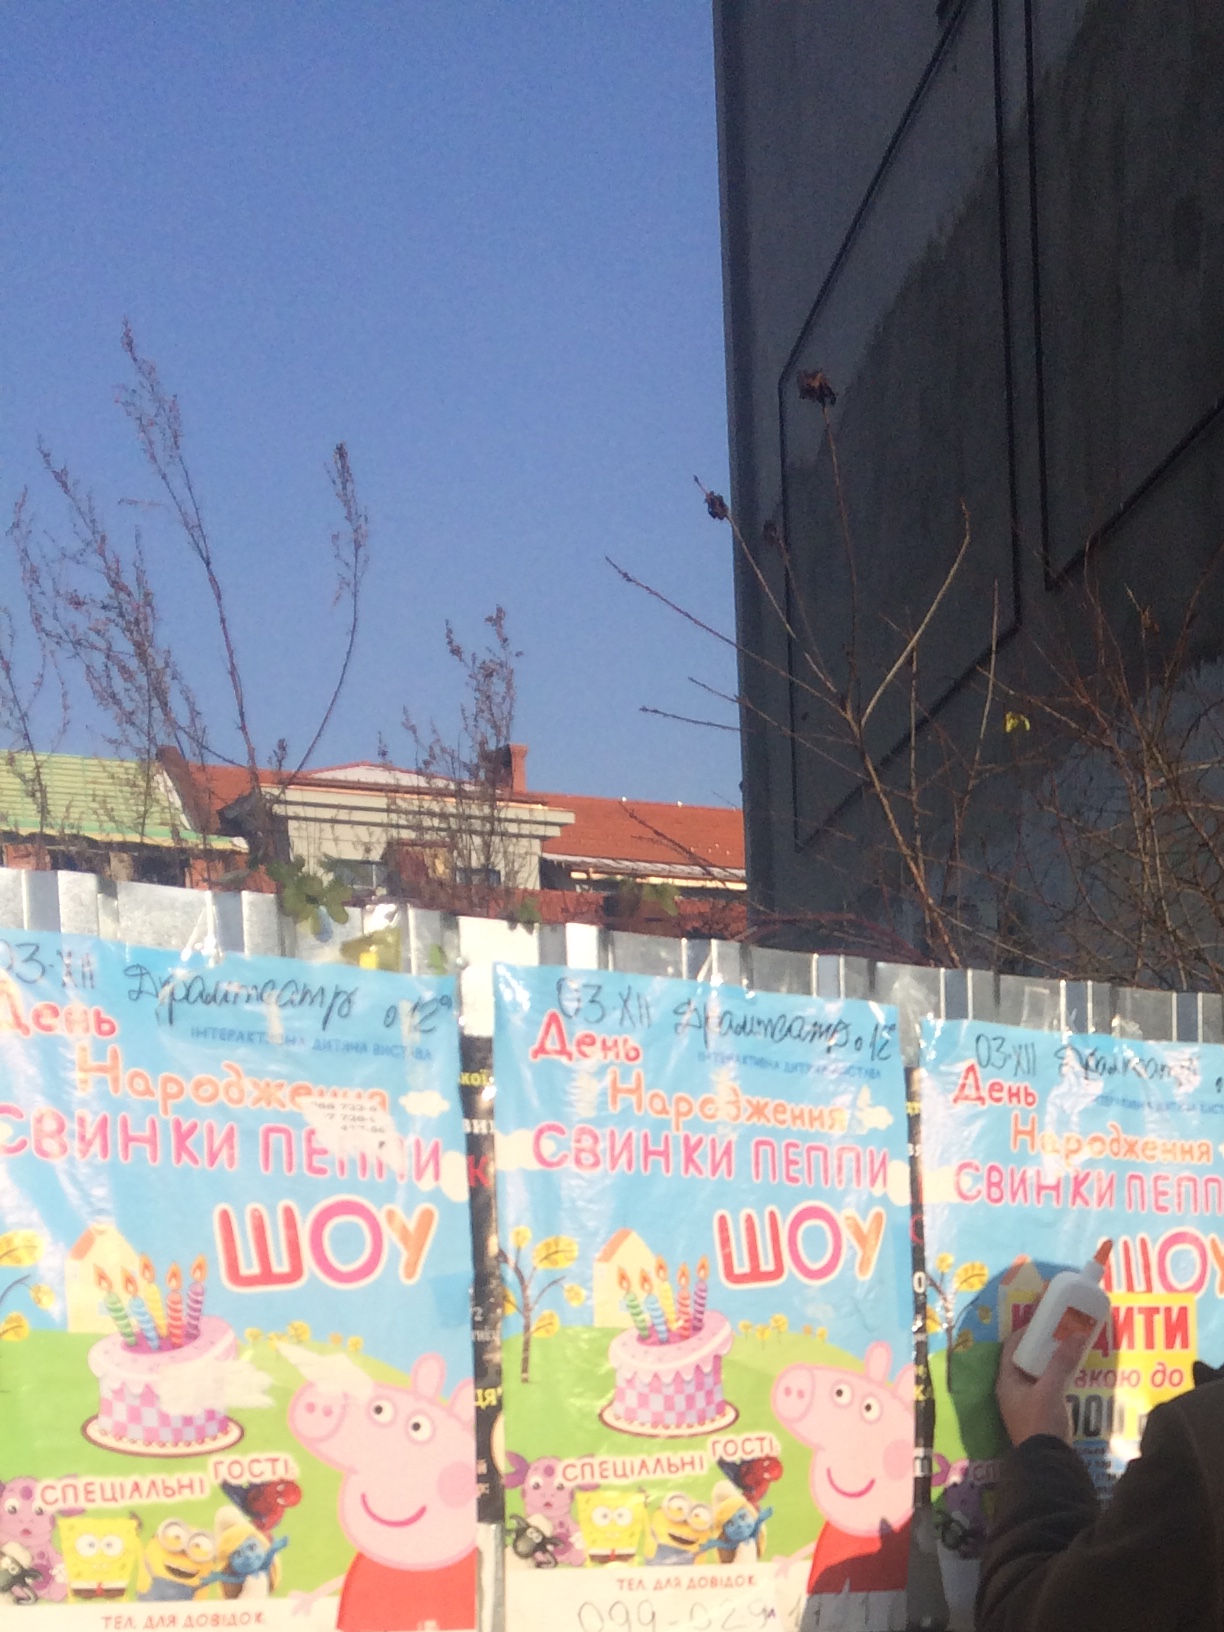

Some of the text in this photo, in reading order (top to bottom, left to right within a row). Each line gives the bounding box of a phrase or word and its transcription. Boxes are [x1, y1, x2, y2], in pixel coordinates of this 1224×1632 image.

[530, 1010, 642, 1063] День
[607, 1067, 849, 1133] Народження
[951, 1061, 1038, 1108] День
[0, 1103, 239, 1171] СВИНКИ
[531, 1121, 890, 1192] СВИНКИ ПЕППИ
[1010, 1112, 1214, 1168] Народження
[953, 1159, 1117, 1211] СВИНКИ
[216, 1196, 437, 1289] ШОУ
[715, 1201, 886, 1287] ШОУ
[1150, 1362, 1184, 1388] до
[40, 1477, 206, 1507] СПЕЦІАЛЬНІ
[562, 1454, 705, 1484] СПЕЦІАЛЬНІ
[653, 1576, 683, 1591] ДЛЯ
[687, 1574, 758, 1590] ДОВІДОК
[143, 1614, 177, 1630] ДЛЯ
